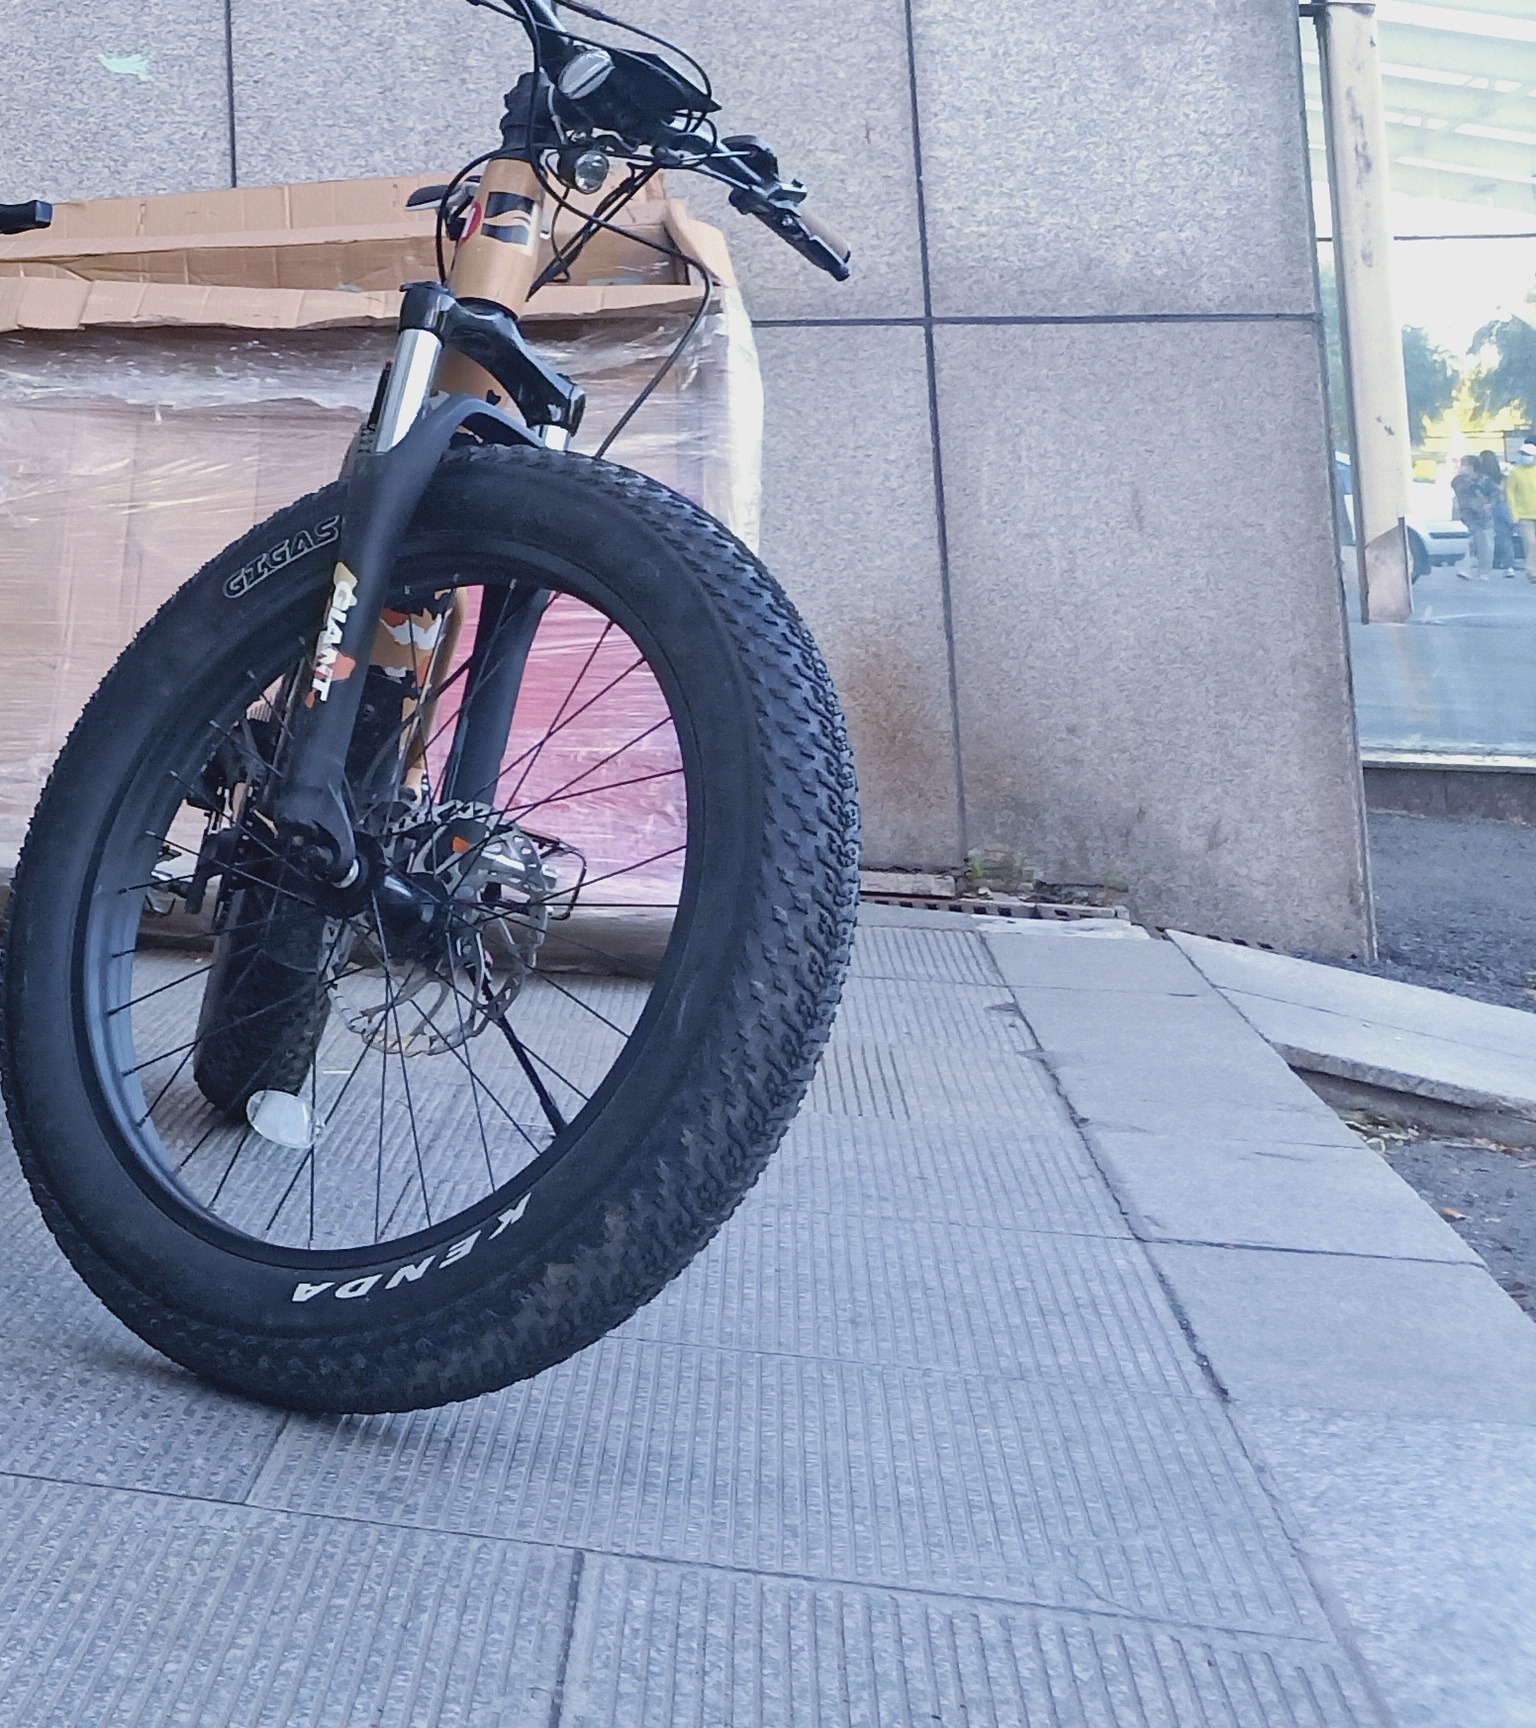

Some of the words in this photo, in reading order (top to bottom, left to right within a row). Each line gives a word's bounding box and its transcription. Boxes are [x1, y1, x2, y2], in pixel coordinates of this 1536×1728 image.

[223, 514, 341, 599] GIGAS
[312, 581, 357, 702] GIANT
[291, 1192, 532, 1302] KENDA
